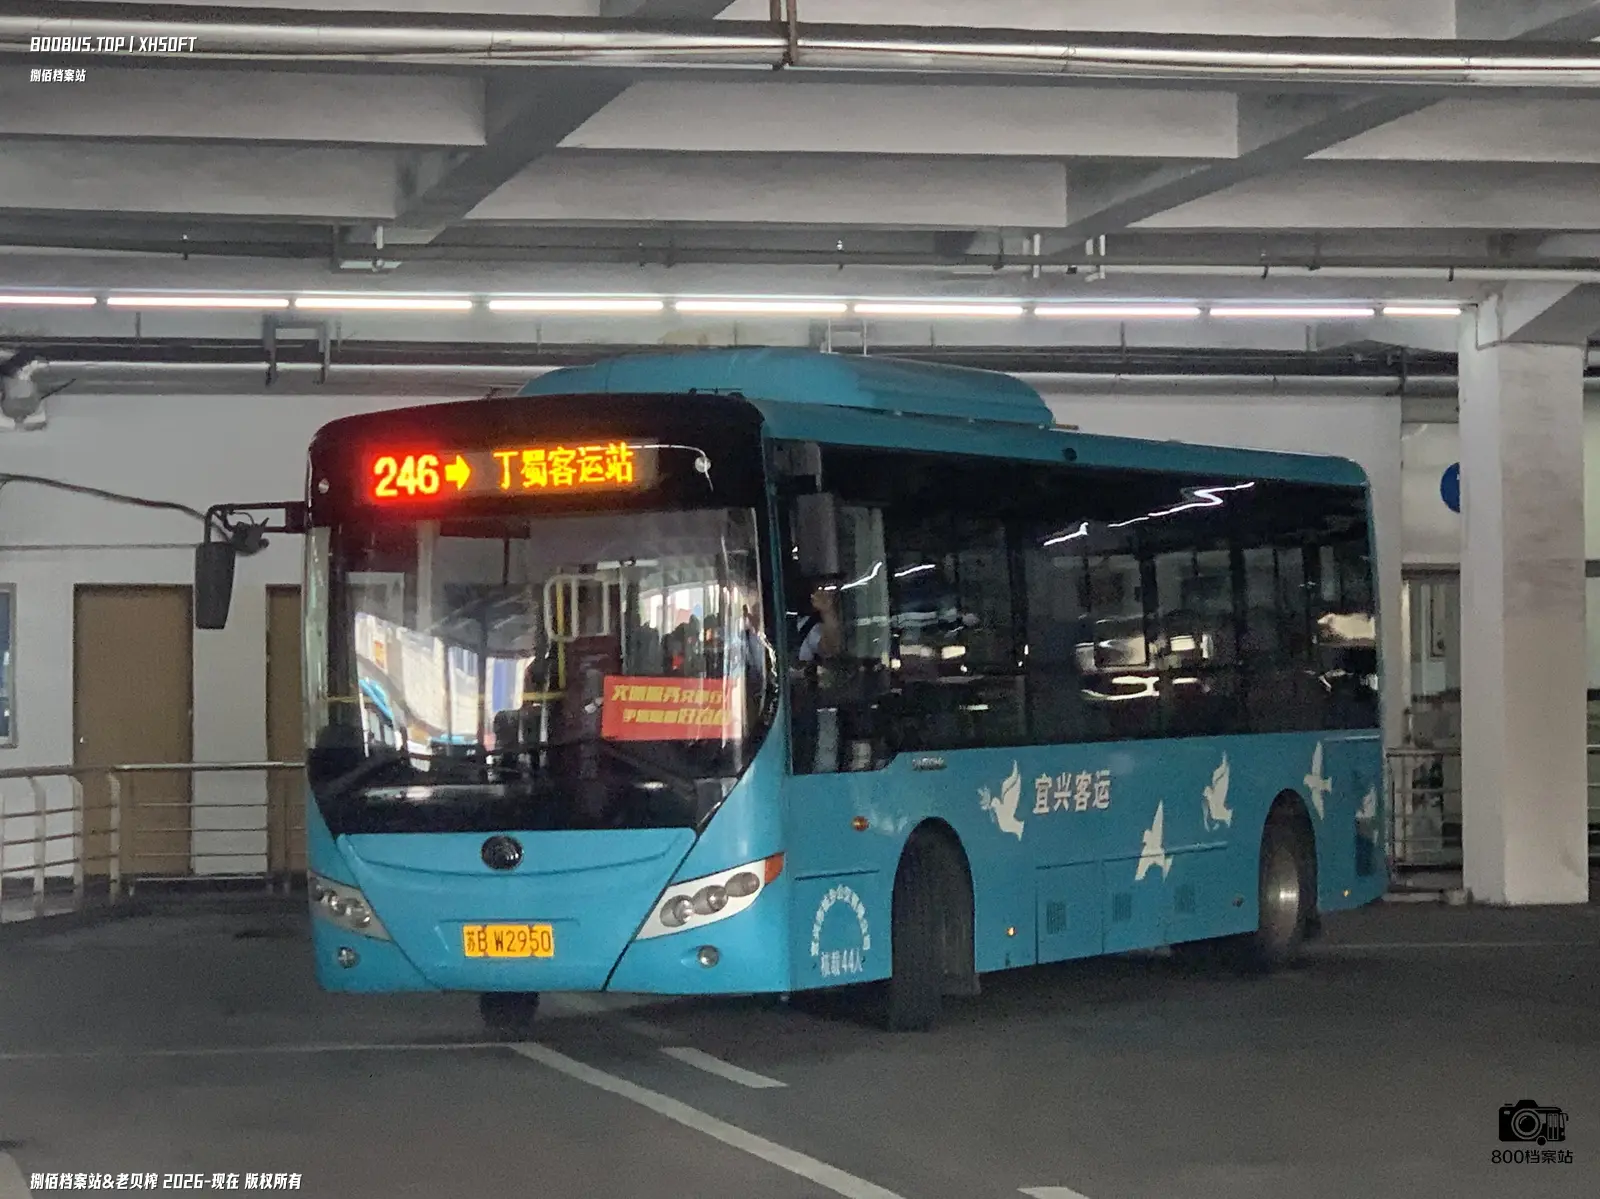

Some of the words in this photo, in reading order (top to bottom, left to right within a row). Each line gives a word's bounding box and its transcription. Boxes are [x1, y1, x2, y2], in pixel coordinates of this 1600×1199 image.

[374, 454, 440, 497] 246
[493, 442, 634, 490] 丁蜀客运站
[1033, 770, 1111, 814] 宜兴客运
[494, 930, 552, 953] W2950
[821, 948, 863, 977] 44人
